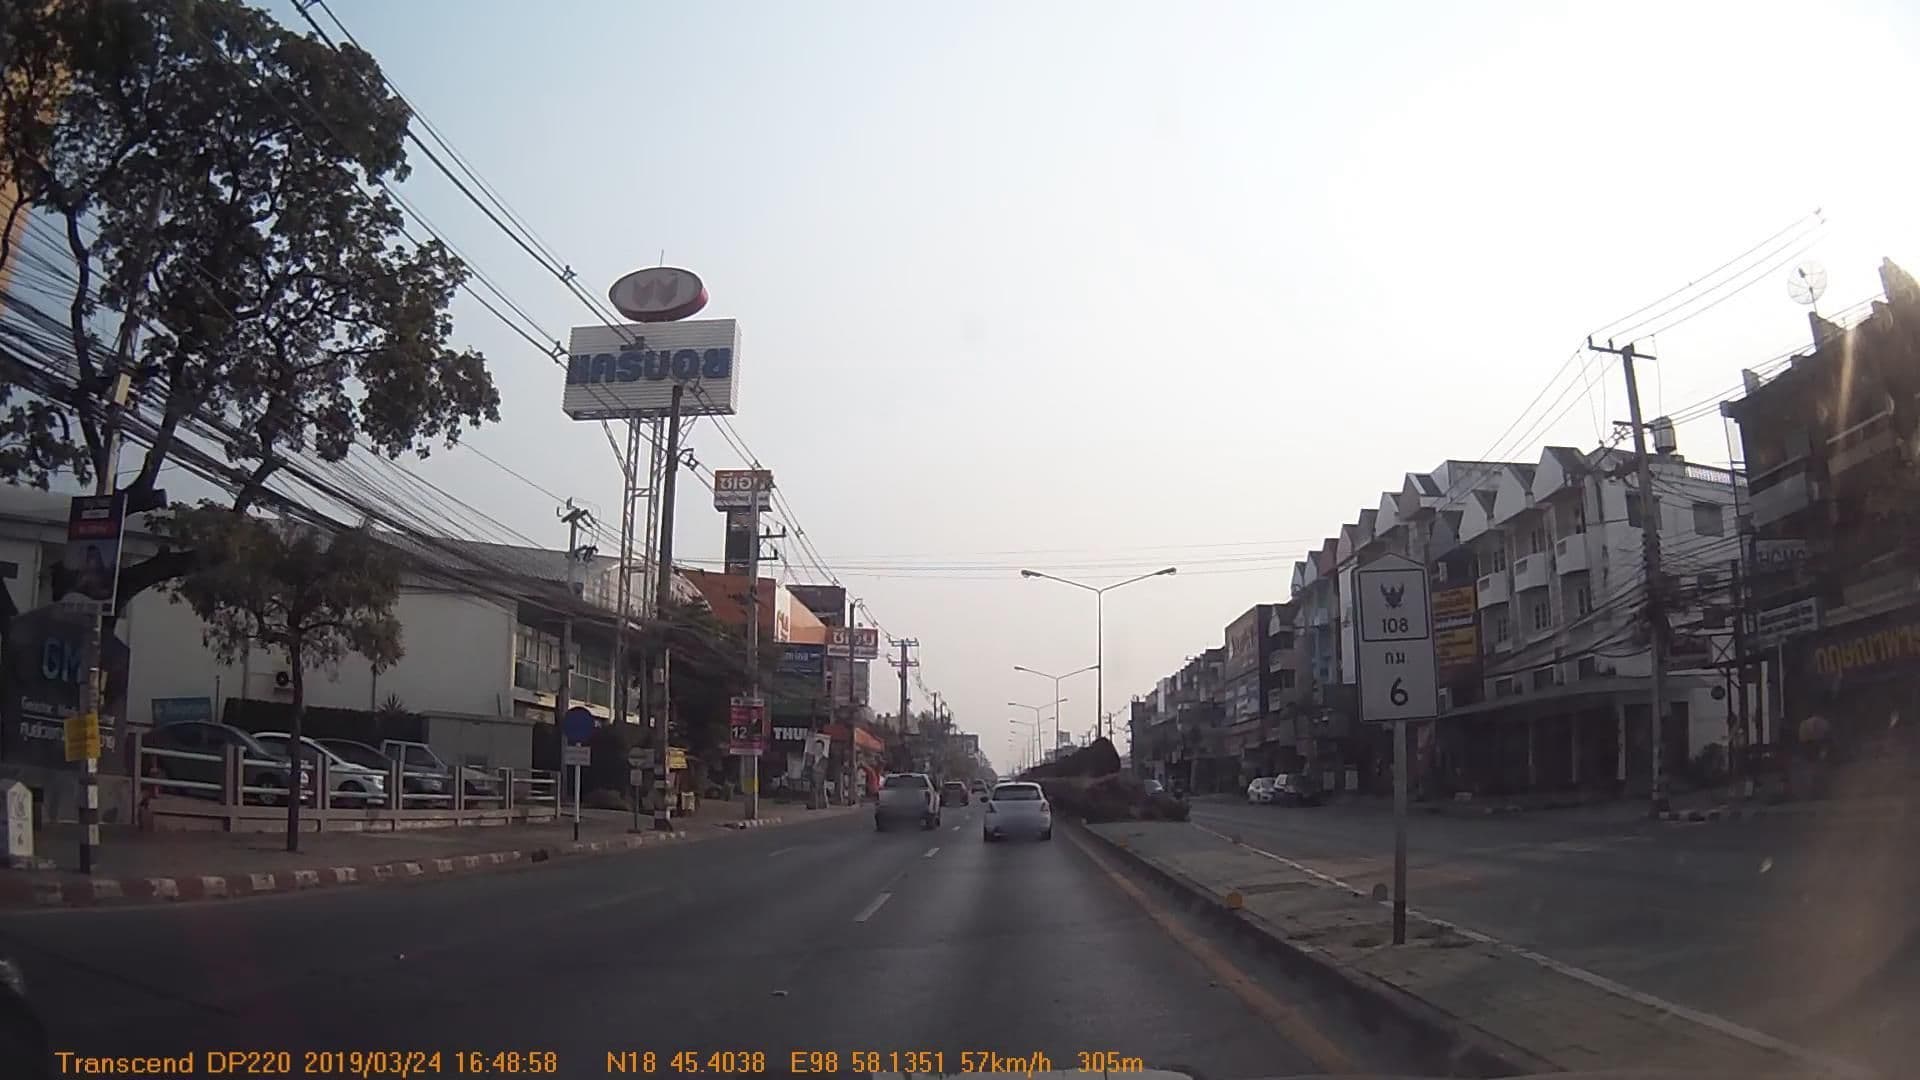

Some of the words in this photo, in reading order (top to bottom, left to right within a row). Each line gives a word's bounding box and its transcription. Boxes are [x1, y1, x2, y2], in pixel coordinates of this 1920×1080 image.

[1382, 618, 1408, 633] 108
[1391, 677, 1409, 706] 6
[732, 725, 748, 740] 12
